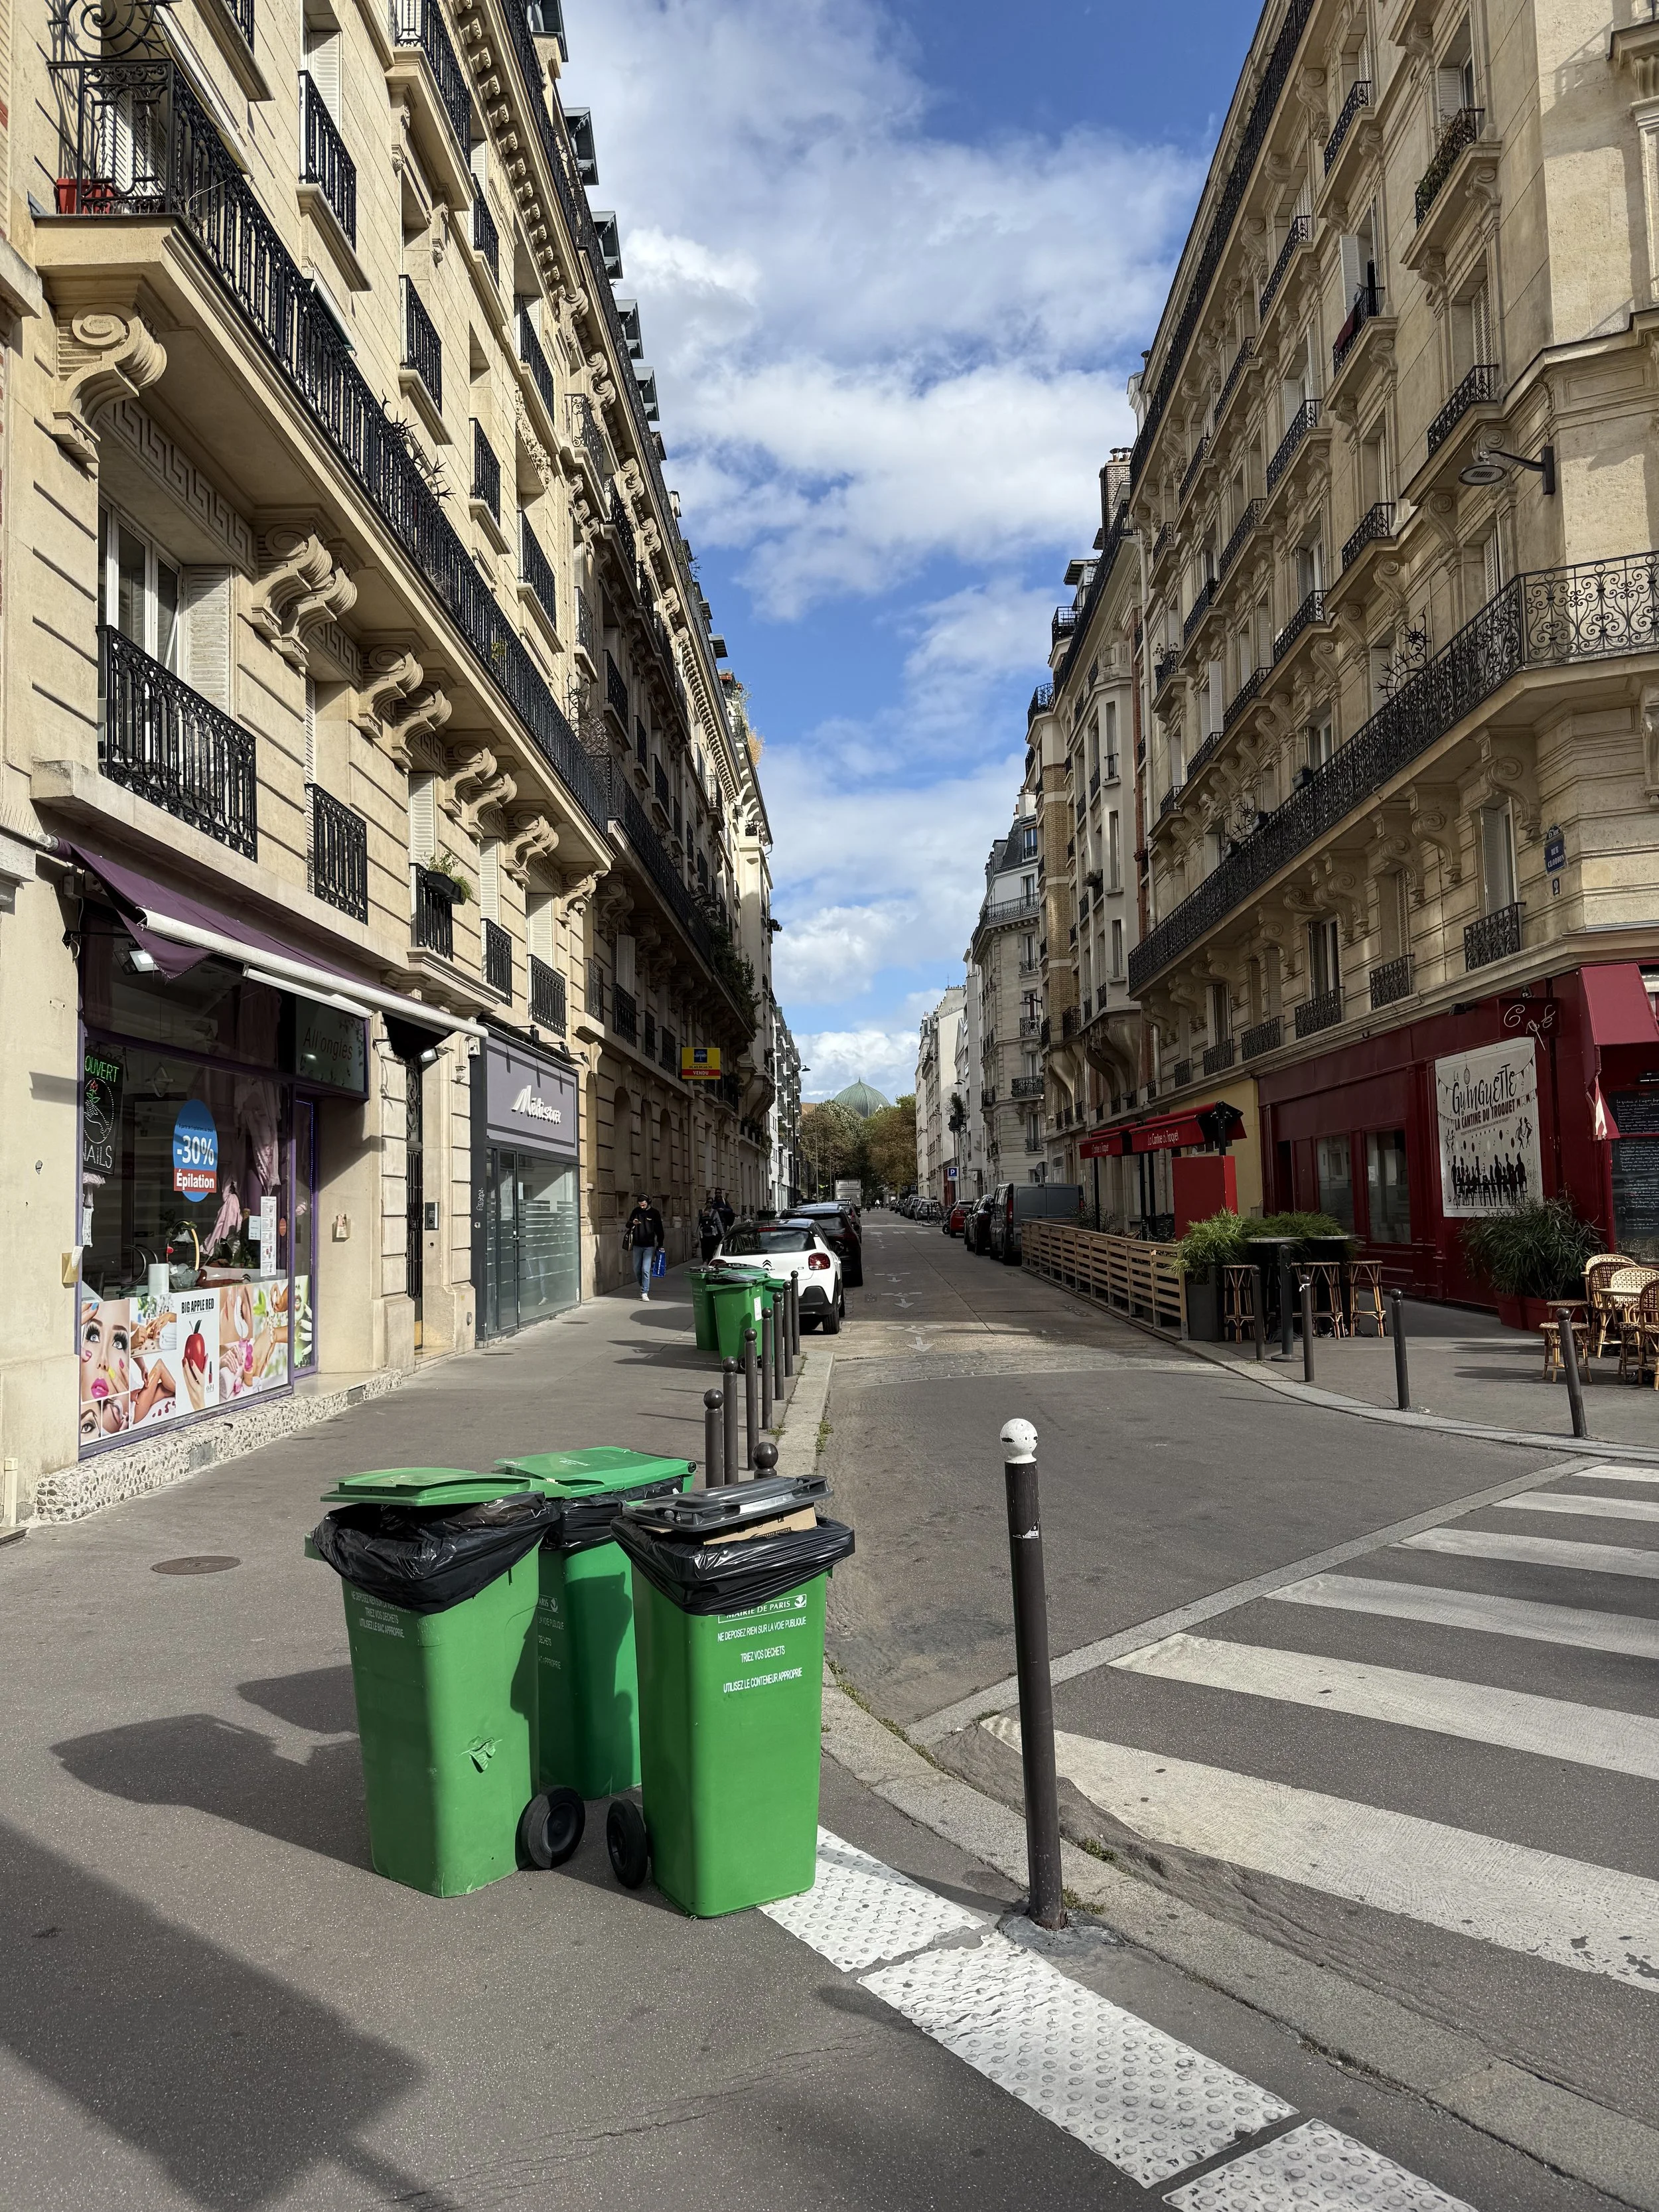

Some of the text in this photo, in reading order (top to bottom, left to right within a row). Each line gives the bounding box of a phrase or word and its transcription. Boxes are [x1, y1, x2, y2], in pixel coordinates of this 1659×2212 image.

[1551, 846, 1559, 855] RUE
[1548, 854, 1565, 868] CLODION
[1553, 880, 1559, 894] 2
[303, 1027, 353, 1061] All'ongles
[84, 1055, 120, 1083] OUVERT
[1455, 1118, 1461, 1131] LA
[1461, 1111, 1481, 1129] CANTINE
[1482, 1108, 1490, 1122] DU
[1490, 1098, 1515, 1119] TROQUET
[83, 1140, 112, 1168] NAILS
[177, 1135, 214, 1166] -30%
[176, 1169, 214, 1190] Épilation
[181, 1297, 214, 1313] BIG APPLE RED
[538, 1597, 549, 1607] ARIS
[770, 1601, 790, 1610] PARIS
[382, 1611, 399, 1624] DECHETS
[717, 1616, 807, 1642] NE DEPOSEZ RIEN SUR LA VOIE PUBLIQUE
[741, 1645, 786, 1663] TRIEZ VOS DECHETS
[723, 1667, 802, 1693] UTILISEZ LE CONTENEUR APPROPRIE
